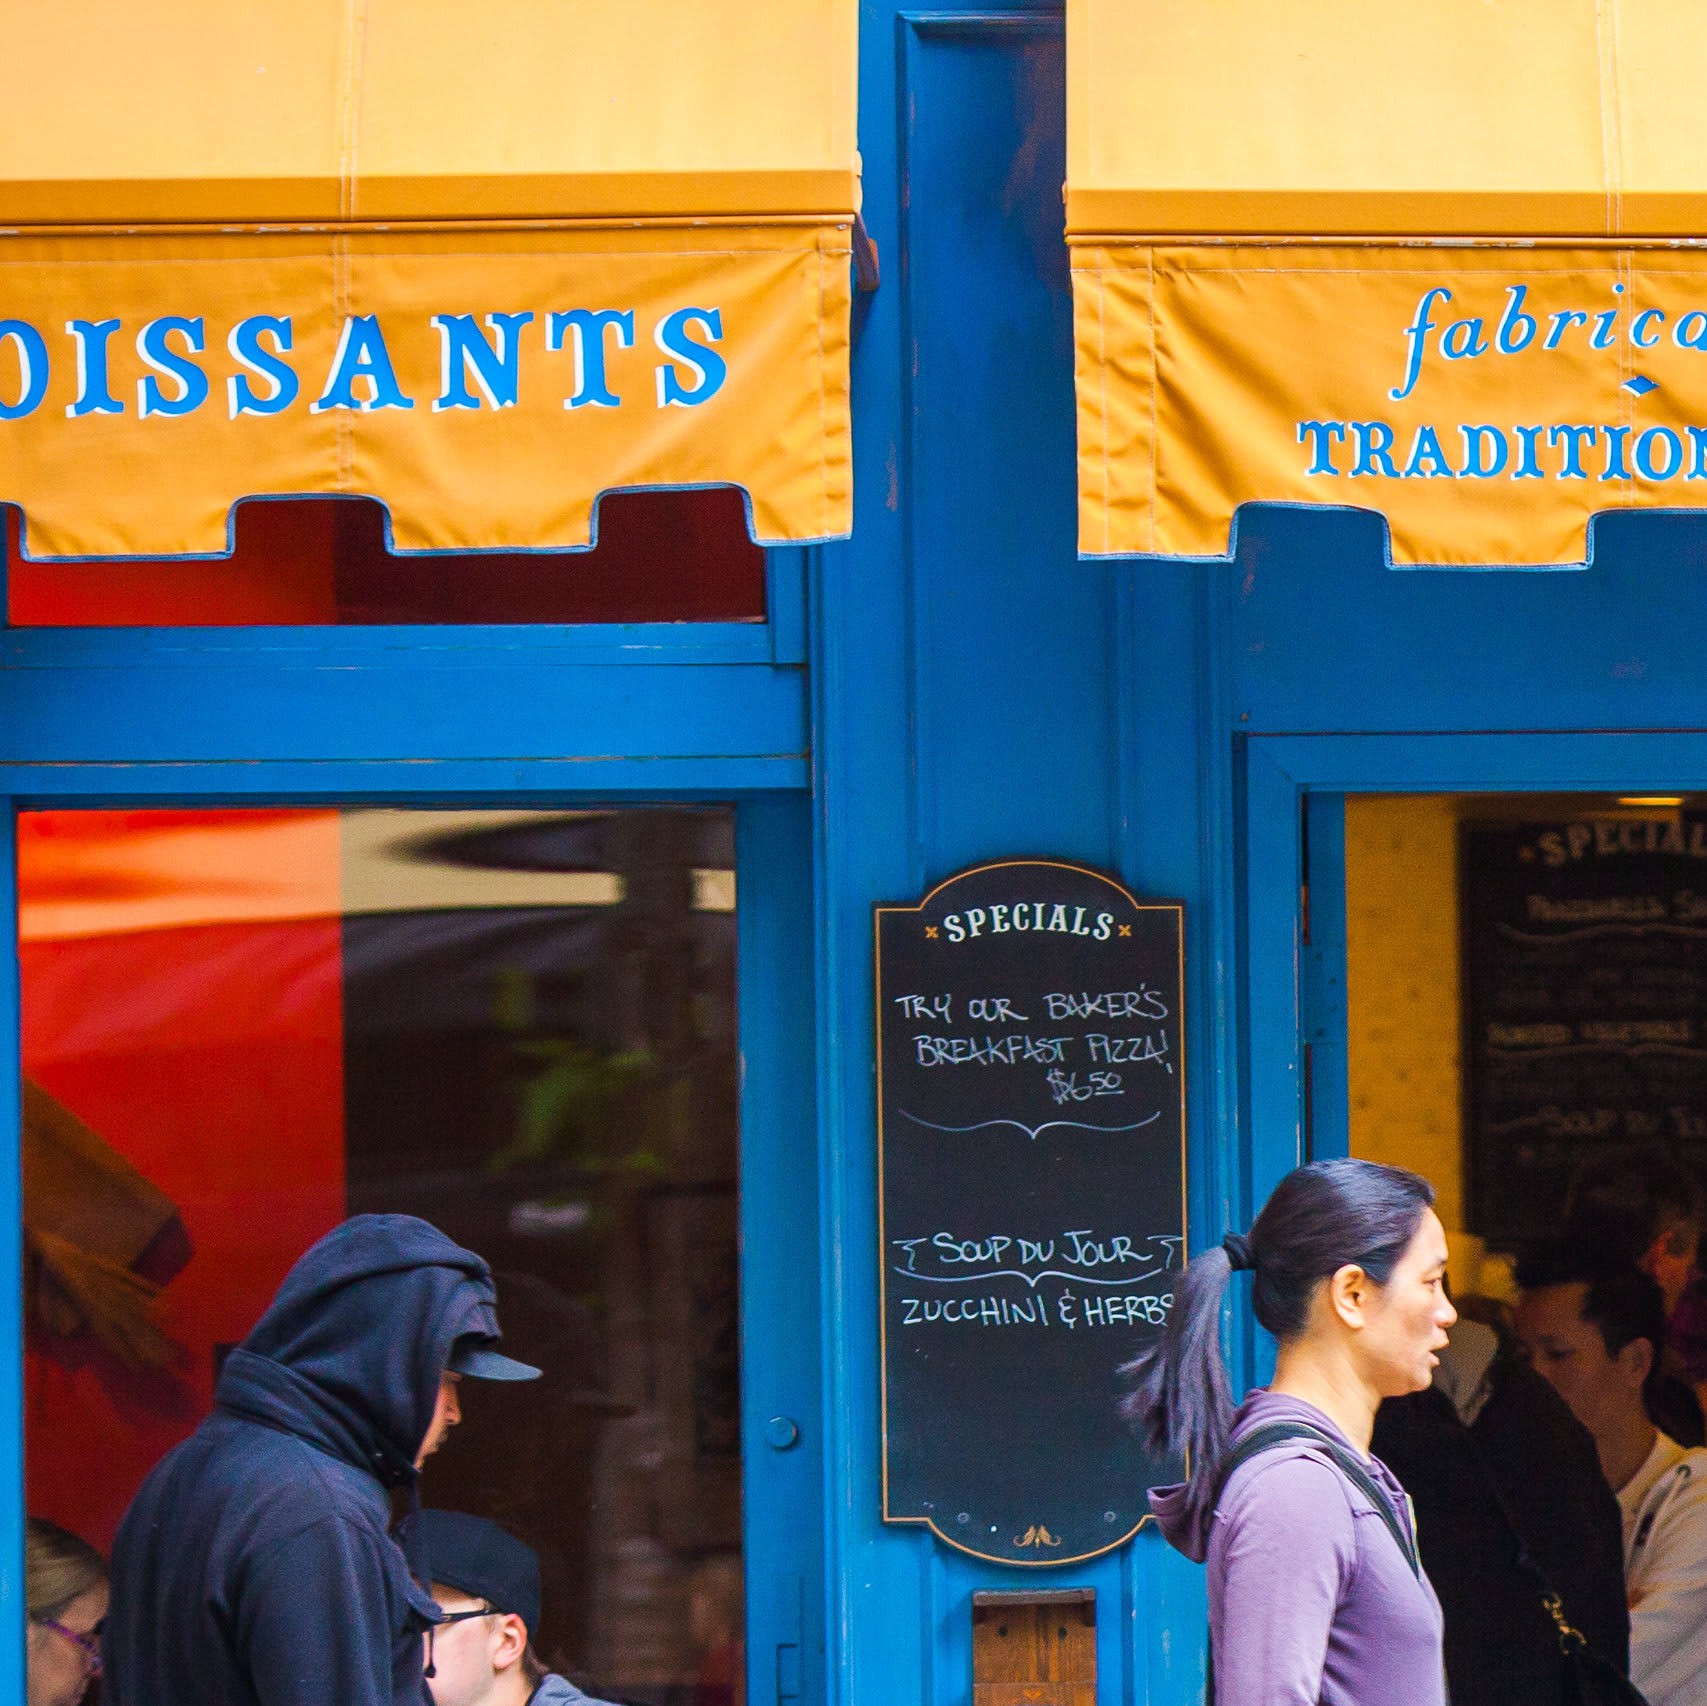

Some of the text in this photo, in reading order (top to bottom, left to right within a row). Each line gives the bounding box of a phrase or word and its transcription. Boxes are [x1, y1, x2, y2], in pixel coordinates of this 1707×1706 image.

[943, 902, 1115, 943] SPECIALS
[895, 982, 1168, 1023] TRY OUR BAKER'S
[912, 1029, 1173, 1074] BREAKFAST PIZZA!
[933, 1230, 1153, 1265] SOUP DU JOUR
[901, 1294, 1049, 1327] ZUCCHINI
[1059, 1288, 1077, 1329] &
